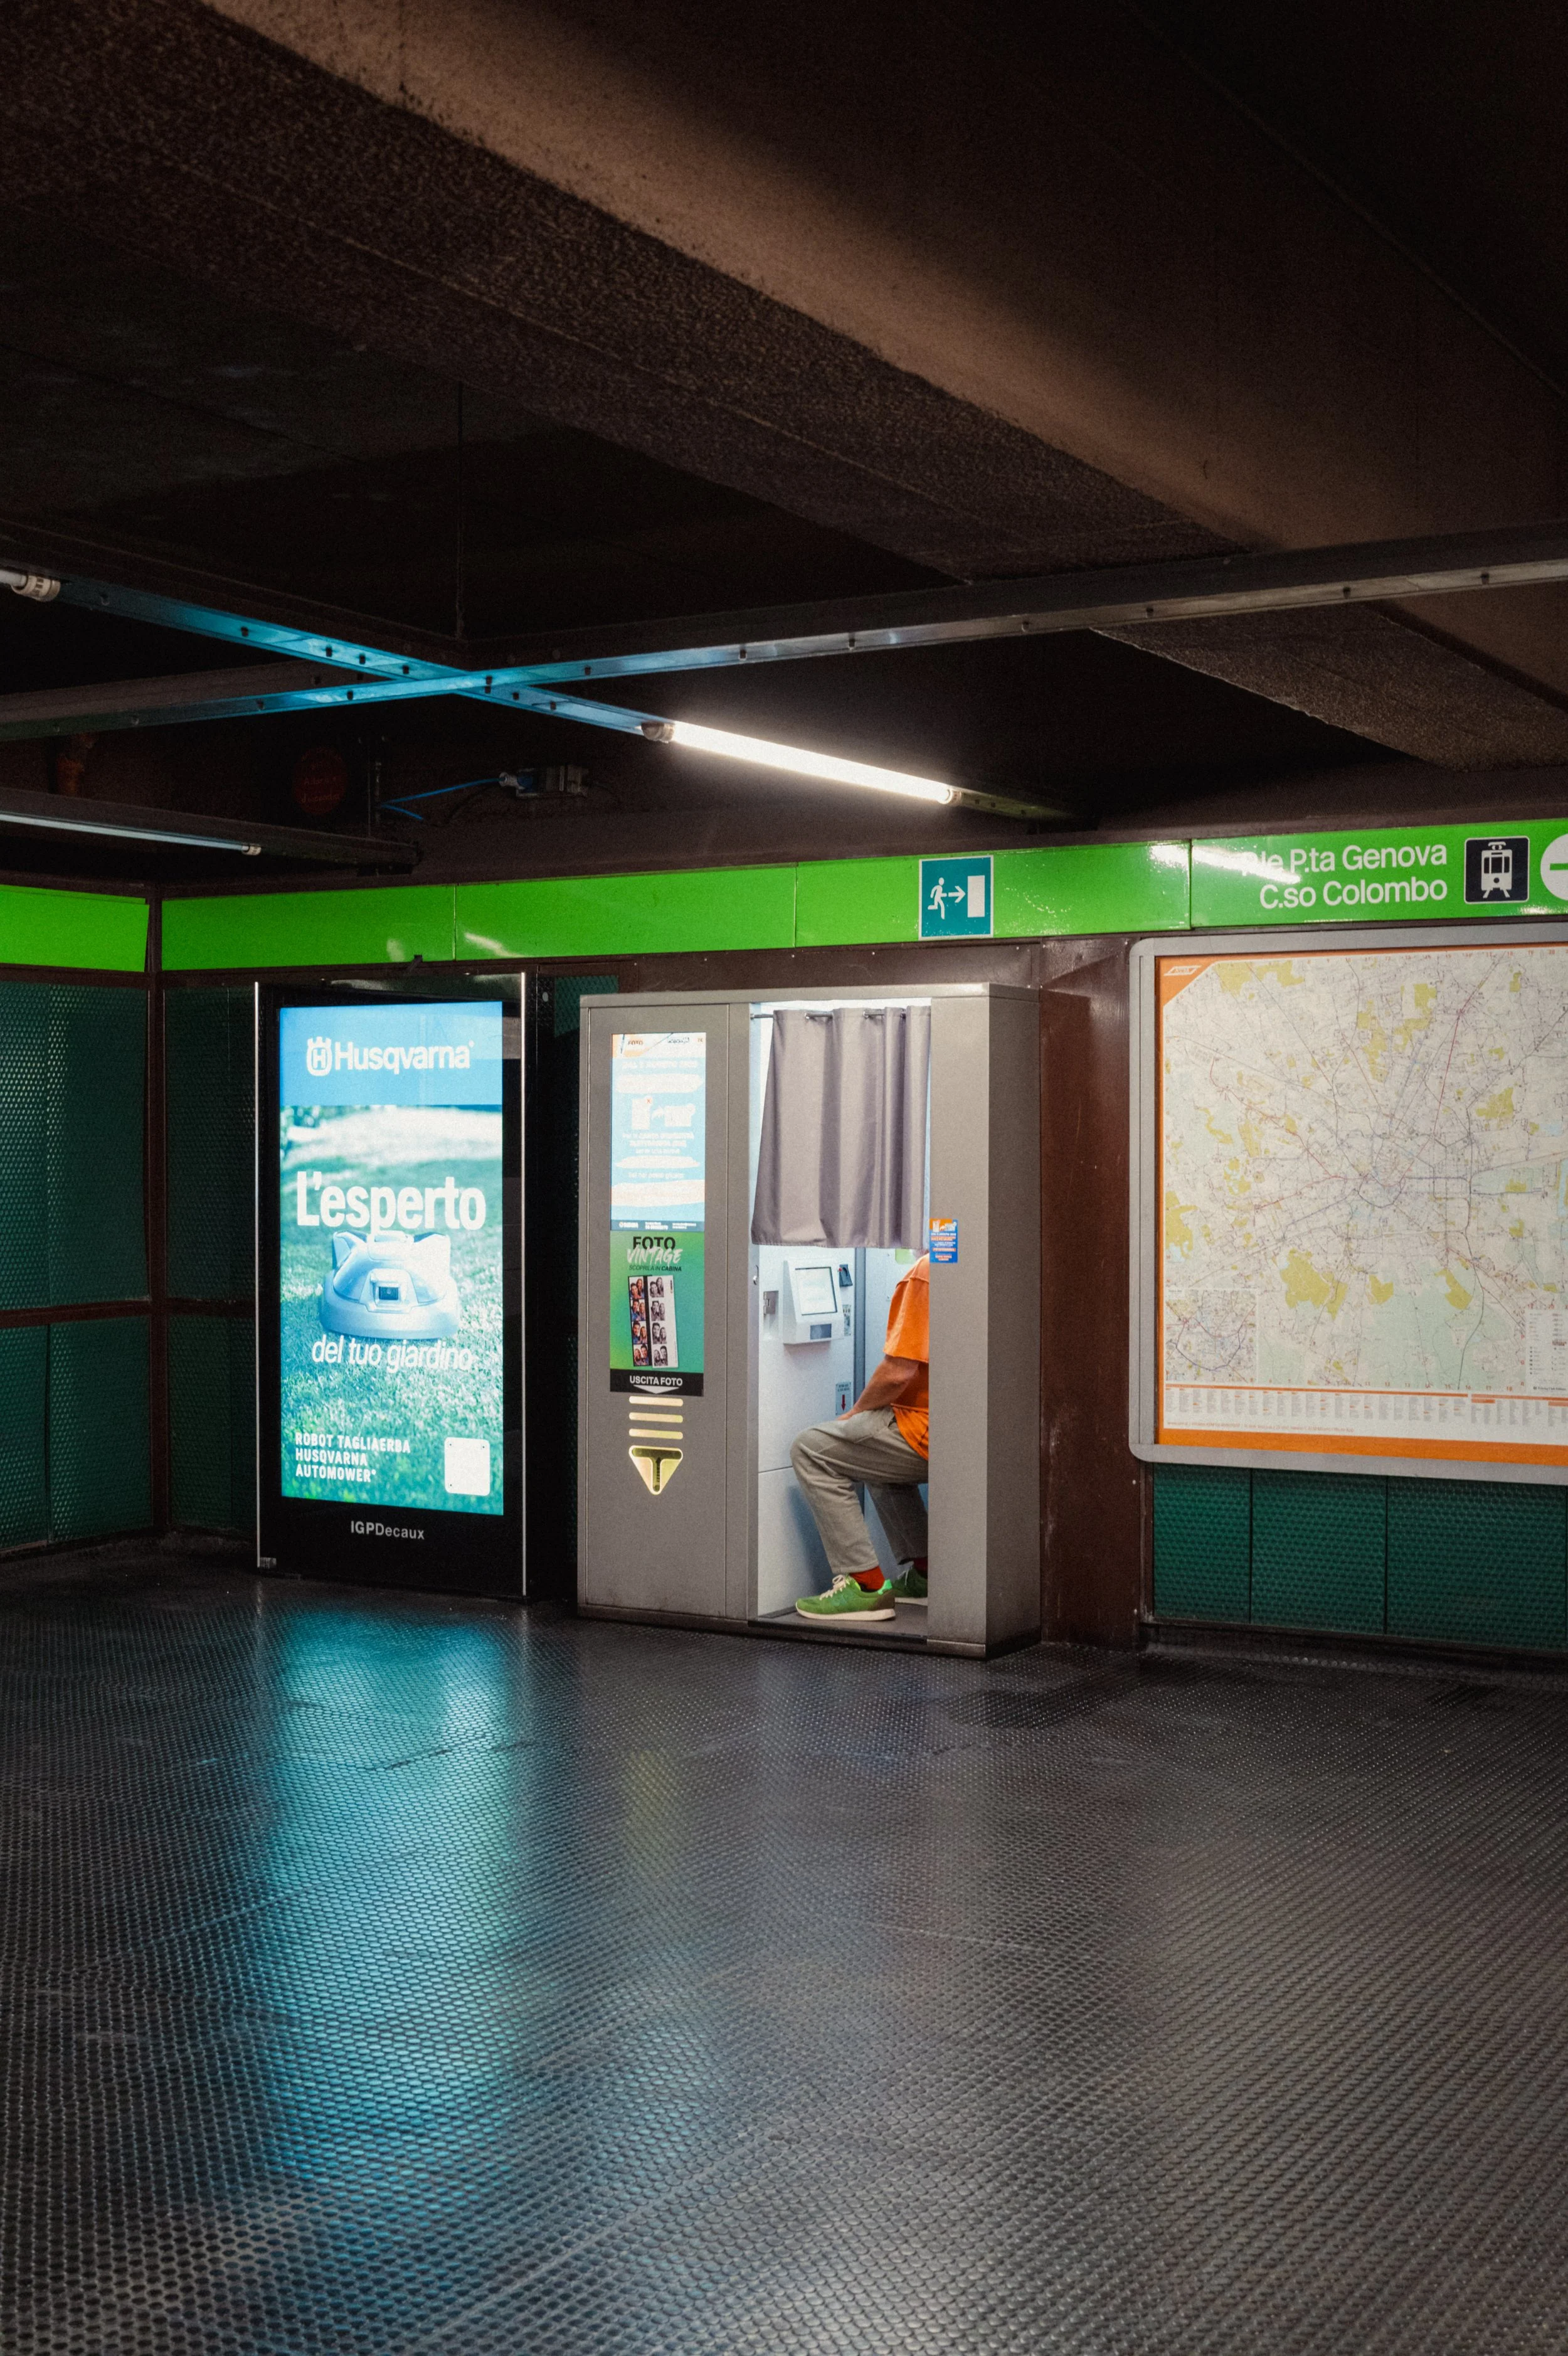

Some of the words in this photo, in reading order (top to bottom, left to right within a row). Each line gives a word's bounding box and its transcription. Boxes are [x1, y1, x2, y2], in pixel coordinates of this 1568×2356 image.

[1290, 847, 1335, 873] P.ta
[1342, 843, 1447, 871] Genova
[1260, 884, 1316, 909] C.so
[1323, 876, 1448, 906] Colombo
[335, 1041, 471, 1075] Husqvarna
[633, 1236, 676, 1250] FOTO
[627, 1244, 683, 1268] VINTAGE
[312, 1334, 344, 1363] del
[349, 1337, 381, 1366] tuo
[386, 1339, 472, 1374] giardino
[629, 1375, 660, 1385] USCITA
[660, 1377, 683, 1386] FOTO
[295, 1432, 334, 1448] ROBOT
[337, 1435, 411, 1453] TAGLIAERBA
[295, 1448, 368, 1467] HUSQVARNA
[351, 1520, 425, 1540] IGPDecaux
